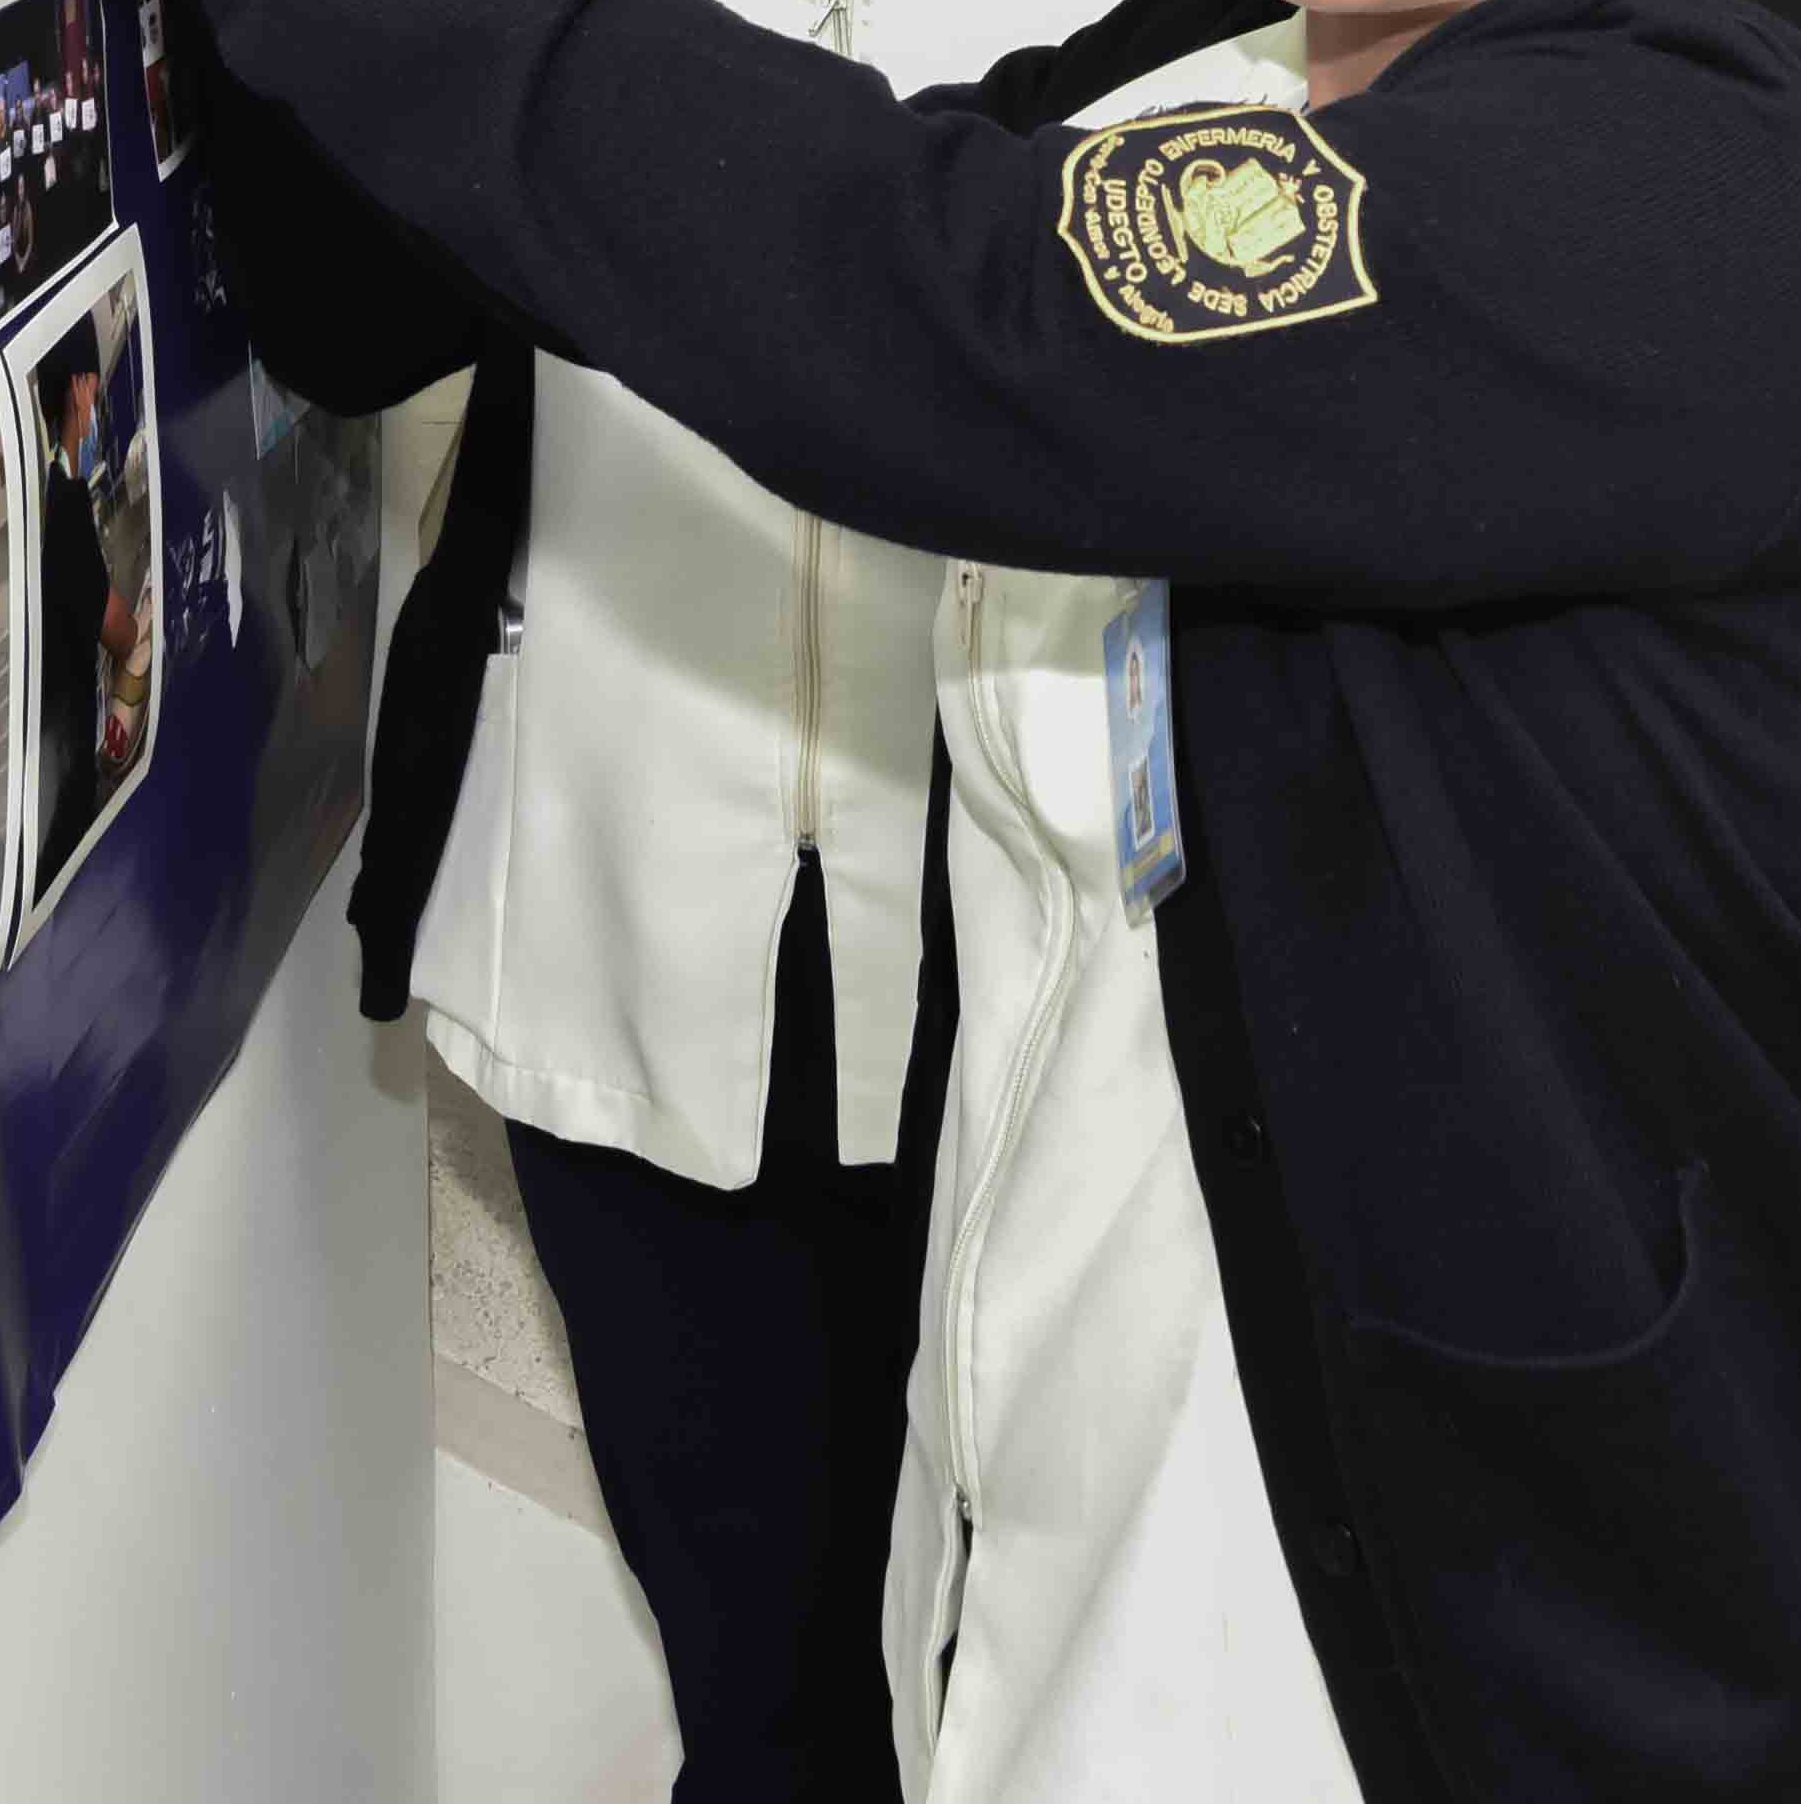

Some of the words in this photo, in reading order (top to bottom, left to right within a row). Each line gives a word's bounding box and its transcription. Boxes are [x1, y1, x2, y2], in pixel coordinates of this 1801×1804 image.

[1158, 126, 1297, 164] ENFERMERIA
[1103, 179, 1148, 284] UDEGTO
[1258, 183, 1339, 313] OBSTETRICIA
[1187, 280, 1248, 317] SEDE
